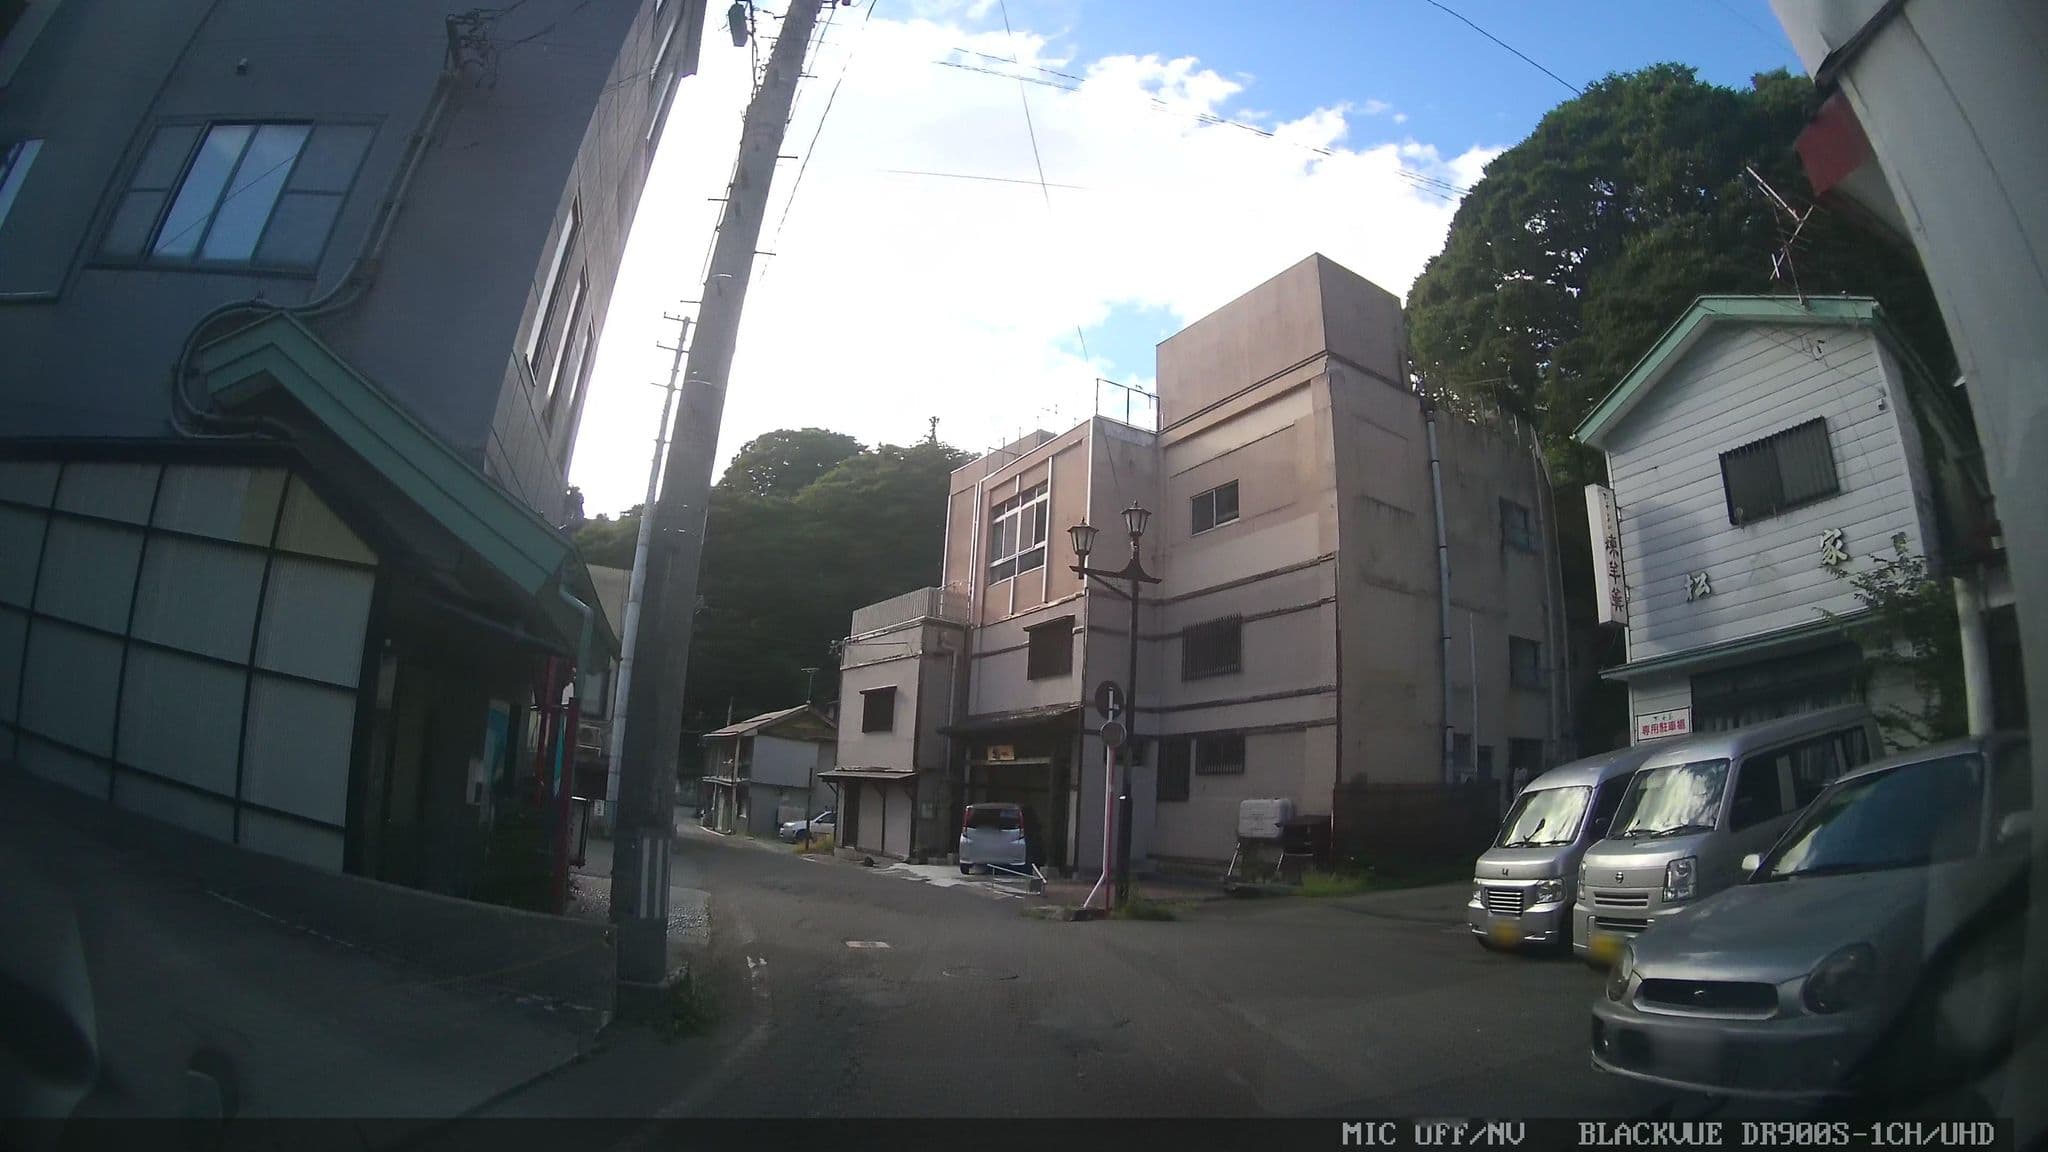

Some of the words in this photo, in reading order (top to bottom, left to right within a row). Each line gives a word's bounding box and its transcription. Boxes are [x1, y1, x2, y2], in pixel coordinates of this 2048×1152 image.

[1641, 719, 1686, 736] 専用駐車場
